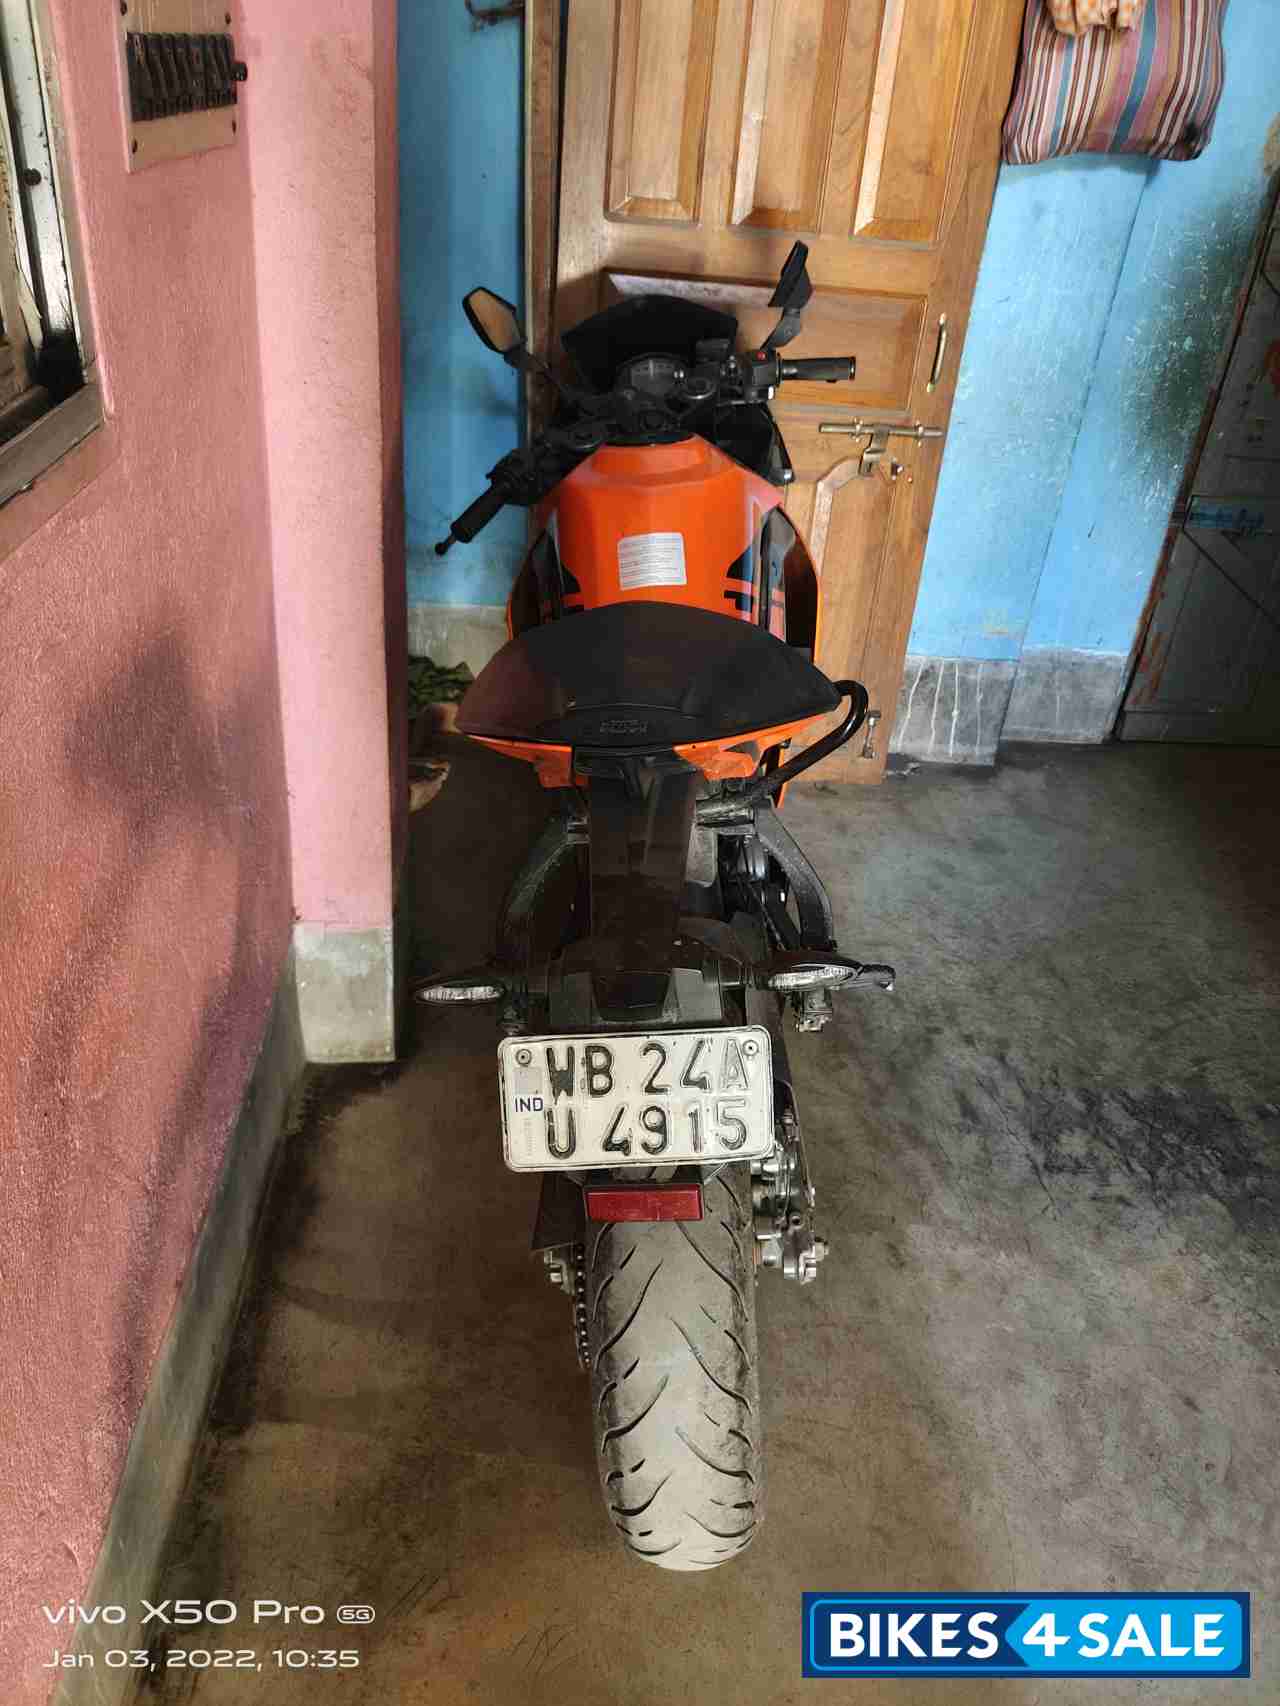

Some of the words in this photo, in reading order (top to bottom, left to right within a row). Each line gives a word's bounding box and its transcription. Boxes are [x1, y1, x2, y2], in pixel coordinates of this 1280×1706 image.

[547, 1045, 612, 1099] WB
[641, 1037, 749, 1095] 24A
[514, 1097, 543, 1112] IND
[545, 1106, 576, 1160] U
[602, 1098, 747, 1157] 4915
